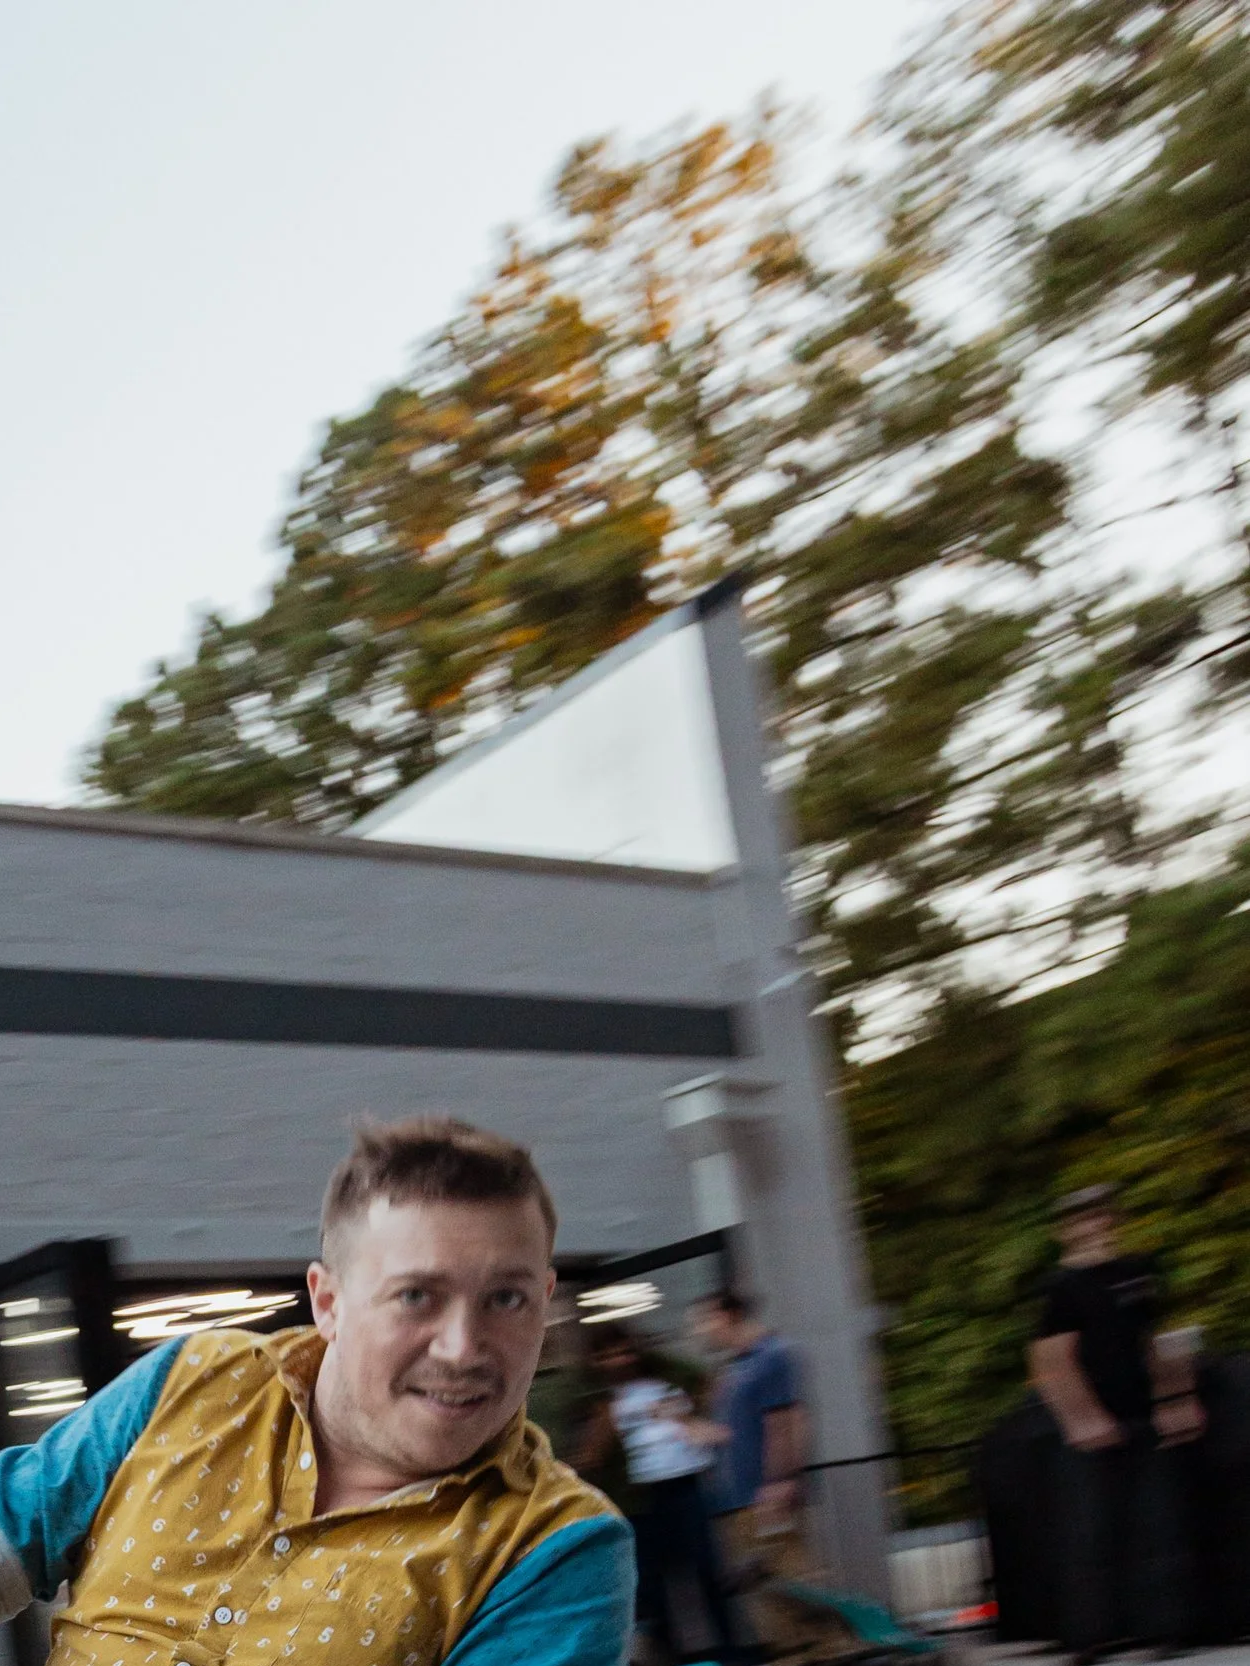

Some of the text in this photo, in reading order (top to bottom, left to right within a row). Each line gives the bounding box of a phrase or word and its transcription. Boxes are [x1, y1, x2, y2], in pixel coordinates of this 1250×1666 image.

[152, 1518, 166, 1532] 6
[193, 1553, 207, 1566] 9
[144, 1595, 156, 1609] 6
[267, 1596, 281, 1611] 8
